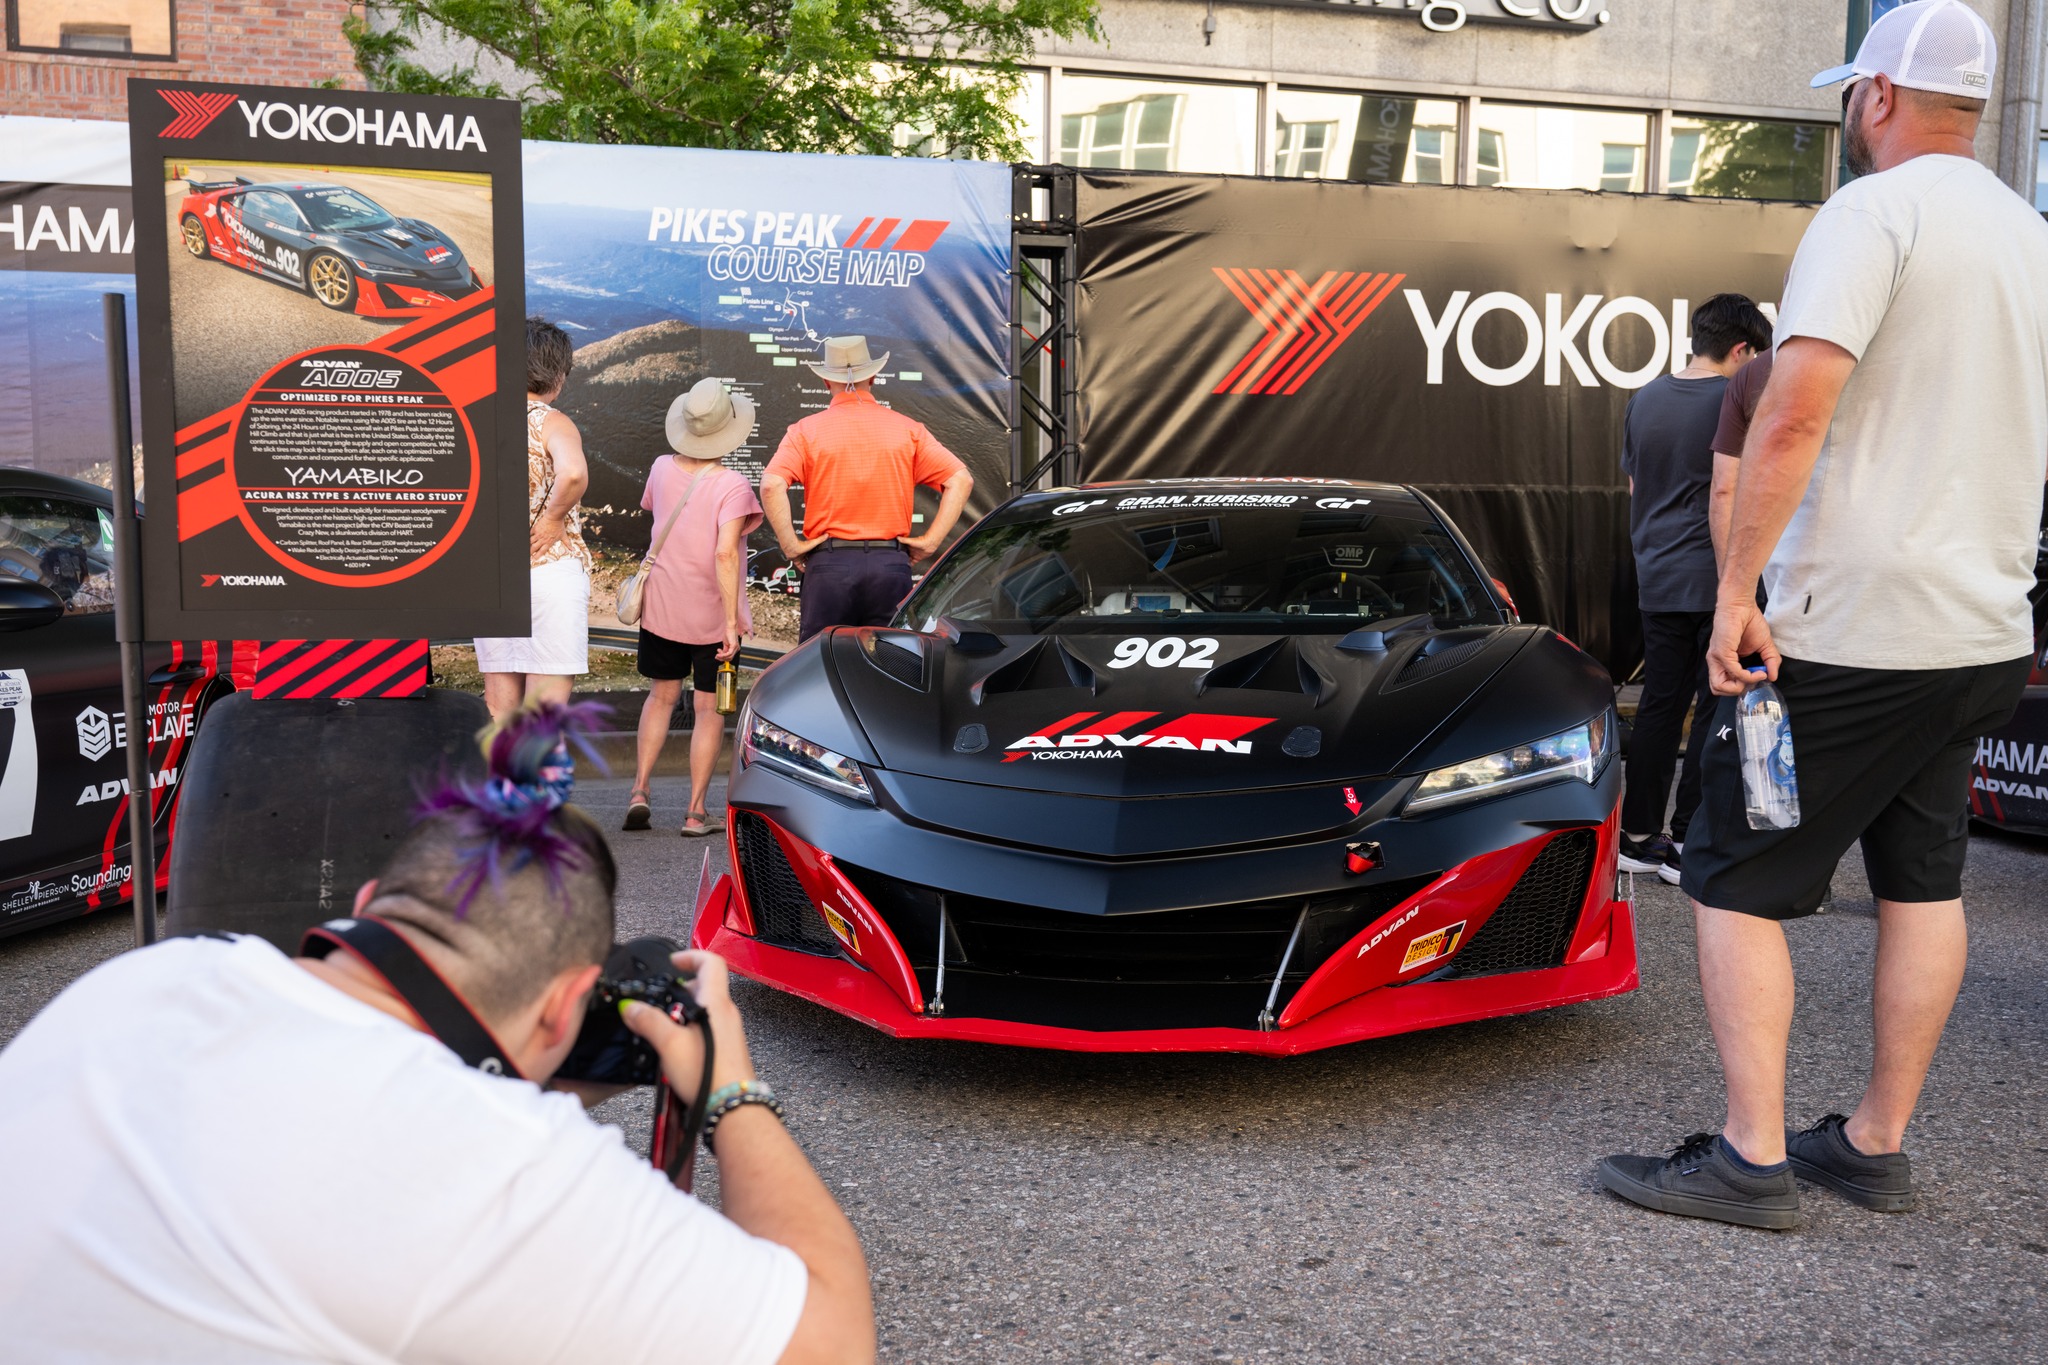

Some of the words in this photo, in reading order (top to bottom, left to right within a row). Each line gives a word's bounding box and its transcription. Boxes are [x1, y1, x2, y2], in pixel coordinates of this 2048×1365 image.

[237, 100, 488, 153] YOKOHAMA
[648, 207, 748, 245] PIKES
[752, 211, 842, 249] PEAK
[236, 246, 278, 268] ADVAN
[275, 246, 301, 278] 902
[707, 244, 843, 284] COURSE
[845, 249, 926, 287] MAP
[1403, 289, 1778, 389] YOKO
[300, 368, 402, 388] A005
[280, 393, 338, 402] OPTIMIZED
[364, 395, 394, 403] PIKES
[284, 466, 424, 486] YAMABIKO
[245, 492, 283, 500] ACURA
[286, 492, 309, 500] NSX
[1118, 495, 1187, 507] GRAN
[1335, 548, 1364, 558] OMP
[220, 576, 286, 586] YOKOHAMA
[1106, 636, 1220, 669] 902
[148, 702, 180, 716] MOTOR
[114, 713, 194, 748] ELAVE
[1004, 734, 1253, 755] ADVAN
[1030, 750, 1124, 760] YOKOHAMA
[1346, 788, 1356, 804] TOW
[71, 864, 132, 892] Sounding
[2, 896, 34, 912] SHELLEY
[38, 884, 70, 900] PIERSON
[76, 889, 96, 898] Hearing
[1357, 905, 1420, 959] ADVAN
[1406, 944, 1440, 963] DESIGN
[1410, 934, 1442, 954] TRIDICO
